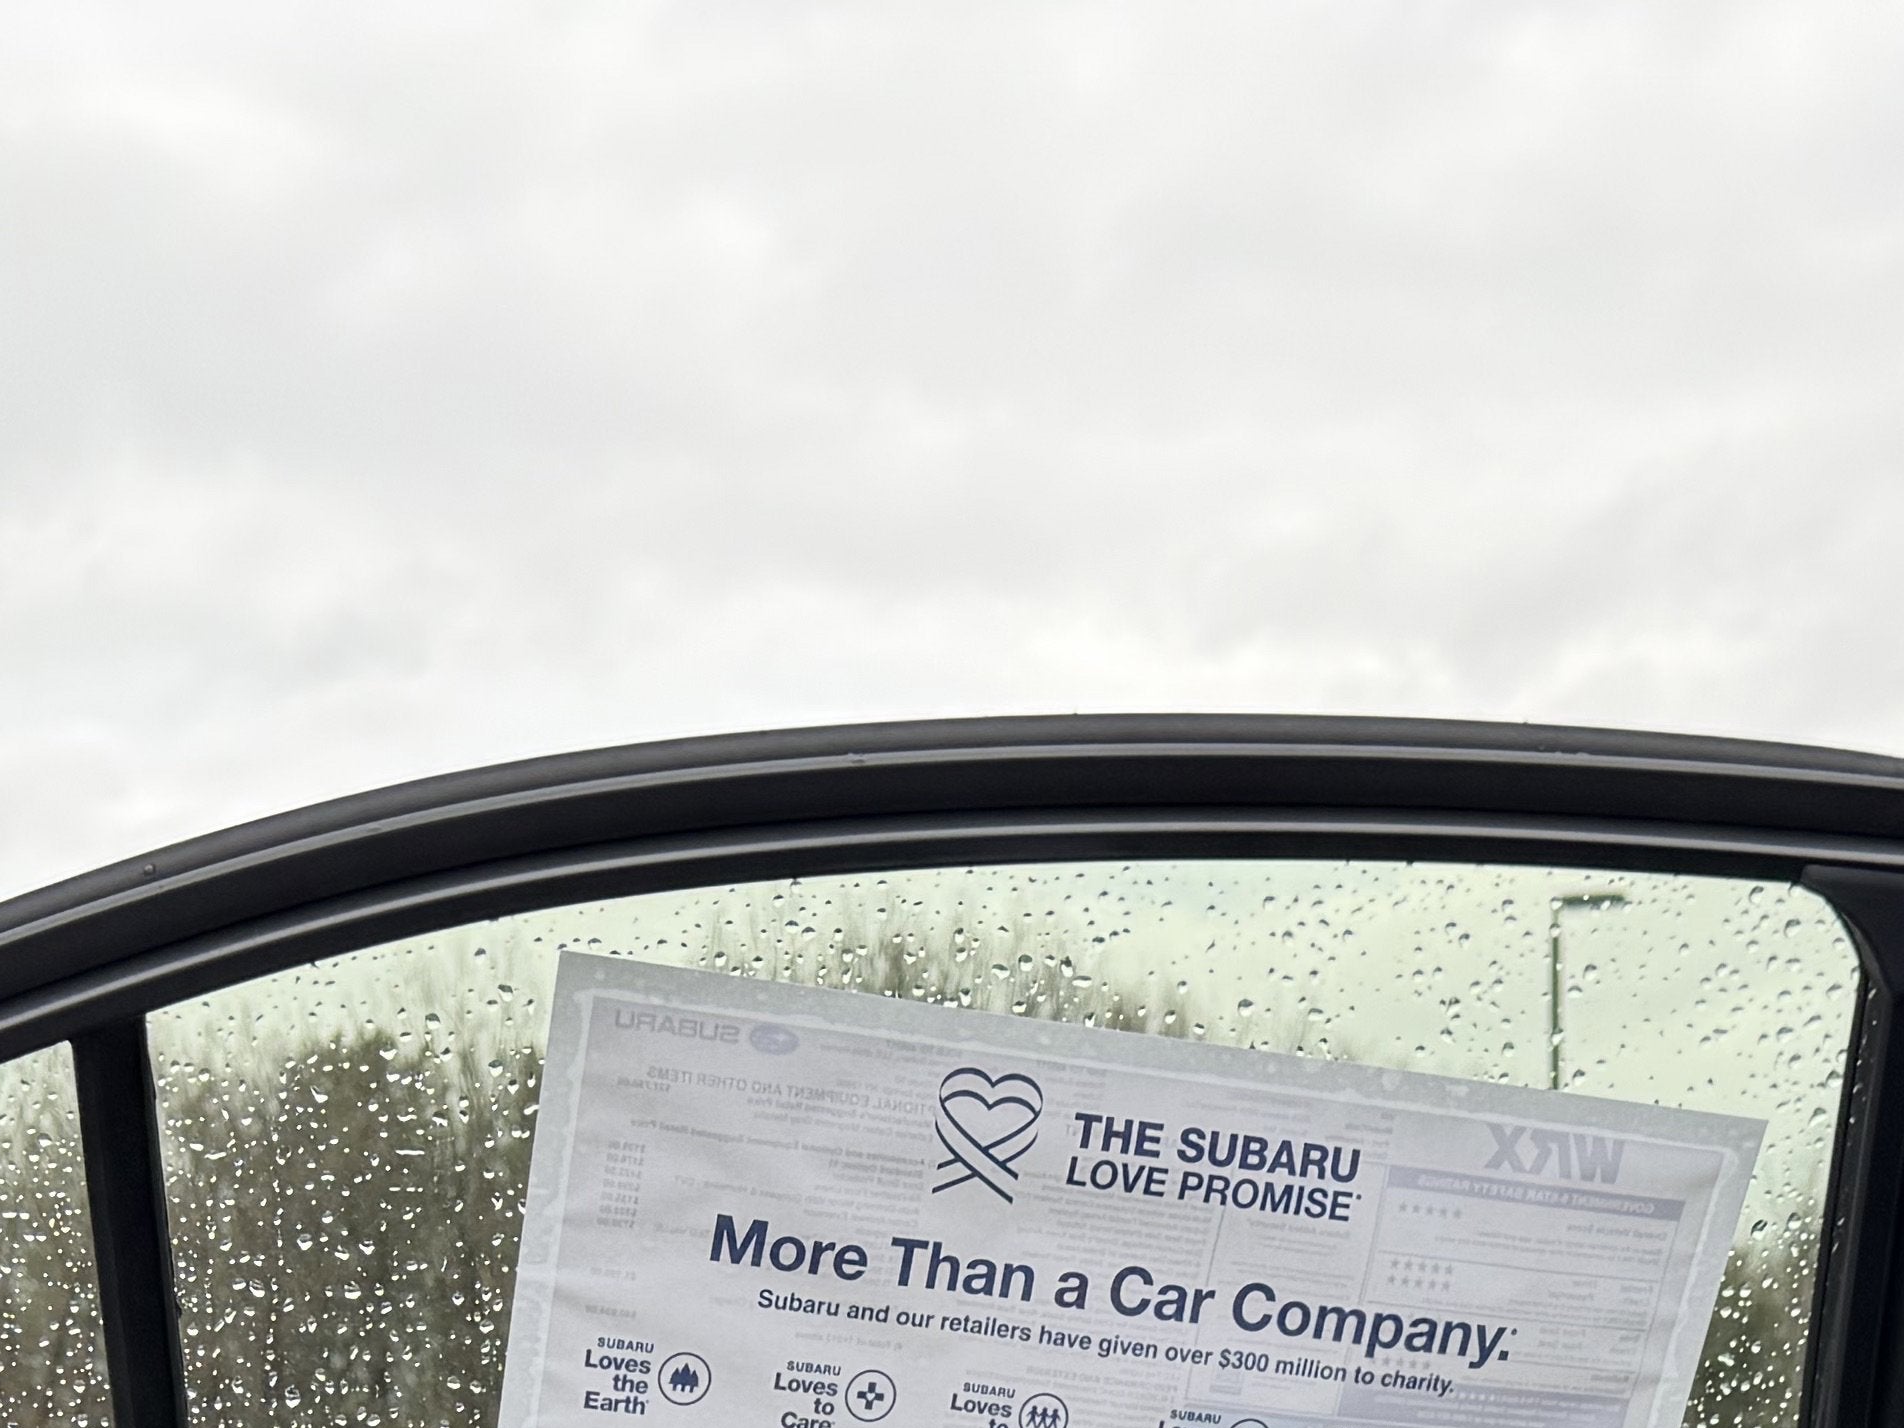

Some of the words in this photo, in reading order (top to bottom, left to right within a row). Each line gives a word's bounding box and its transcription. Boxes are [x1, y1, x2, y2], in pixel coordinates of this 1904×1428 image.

[1074, 1111, 1165, 1159] THE
[1176, 1126, 1361, 1184] SUBARU
[1065, 1155, 1169, 1198] LOVE
[709, 1213, 868, 1281] More
[890, 1236, 1035, 1302] Than
[1053, 1271, 1089, 1310] a
[1109, 1265, 1217, 1324] Car
[597, 1336, 655, 1354] SUBARU
[757, 1288, 841, 1317] Subaru
[846, 1304, 891, 1324] and
[895, 1311, 936, 1329] our
[940, 1314, 1032, 1342] retailers
[1038, 1324, 1093, 1351] have
[1097, 1334, 1158, 1360] given
[1164, 1346, 1214, 1366] over
[1218, 1348, 1270, 1373] $300
[1274, 1357, 1348, 1382] million
[1353, 1366, 1375, 1385] to
[1380, 1370, 1454, 1398] charity.
[584, 1348, 652, 1375] Loves
[786, 1360, 842, 1377] SUBARU
[612, 1373, 649, 1395] the
[773, 1371, 839, 1397] Loves
[963, 1381, 1016, 1399] SUBARU
[813, 1397, 835, 1416] to
[949, 1392, 1013, 1419] Loves
[1169, 1409, 1222, 1425] SUBARU
